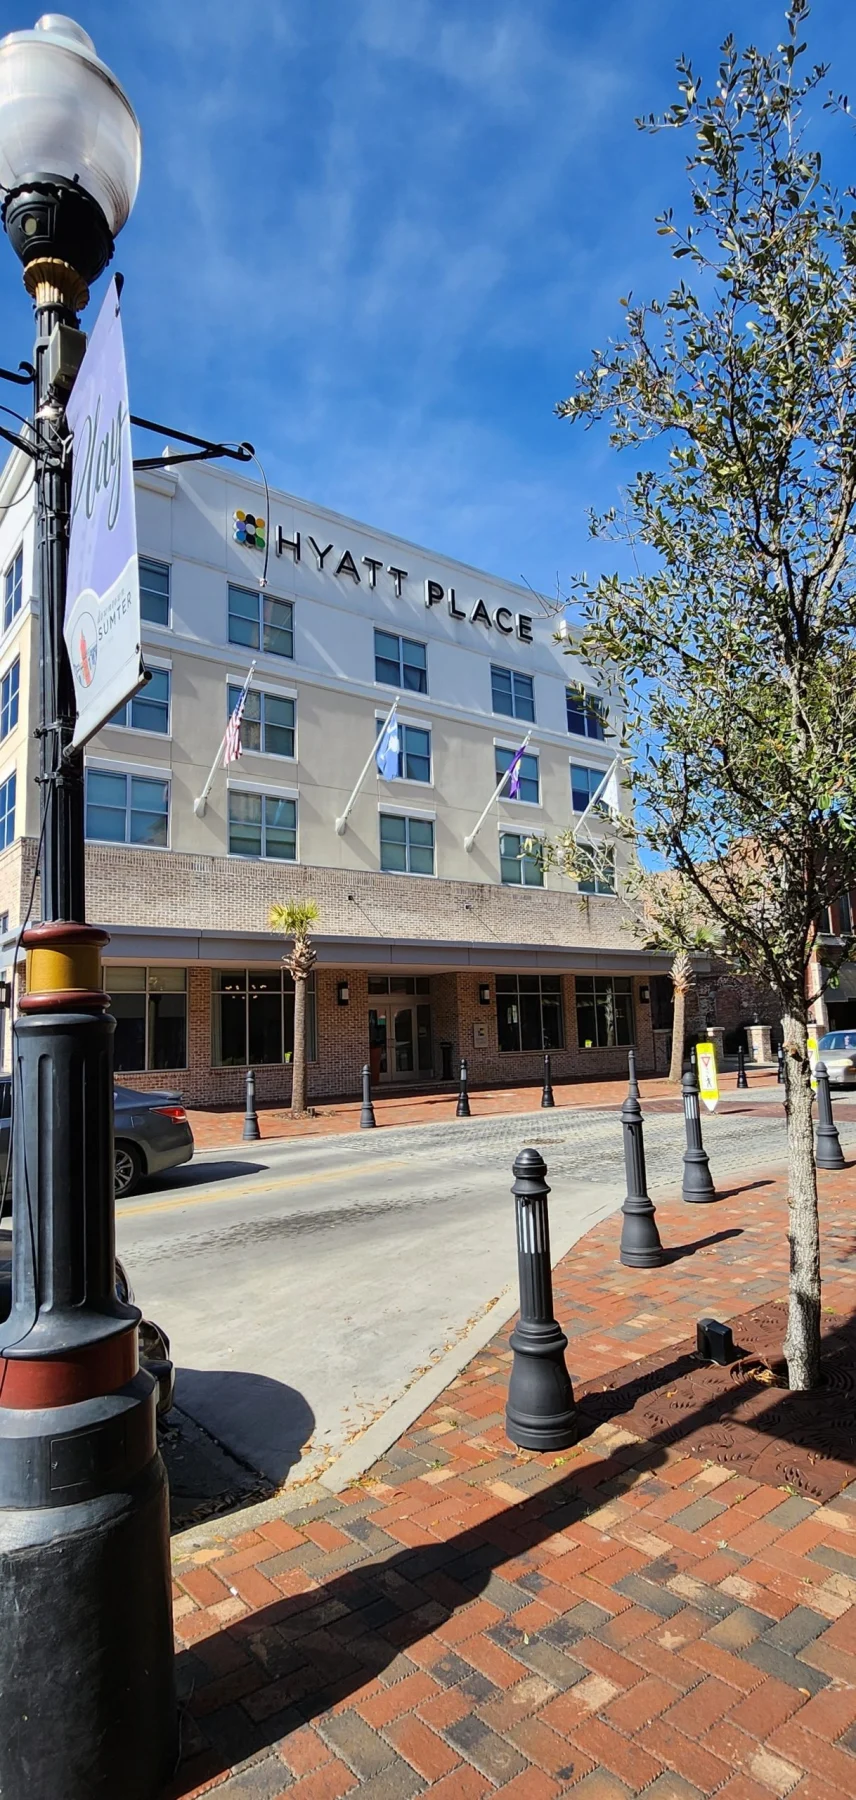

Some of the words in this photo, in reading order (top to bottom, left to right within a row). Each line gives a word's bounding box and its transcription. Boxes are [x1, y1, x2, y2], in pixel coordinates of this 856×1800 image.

[98, 591, 132, 641] SUMTER
[275, 525, 408, 597] HYATT
[424, 579, 533, 643] PLACE
